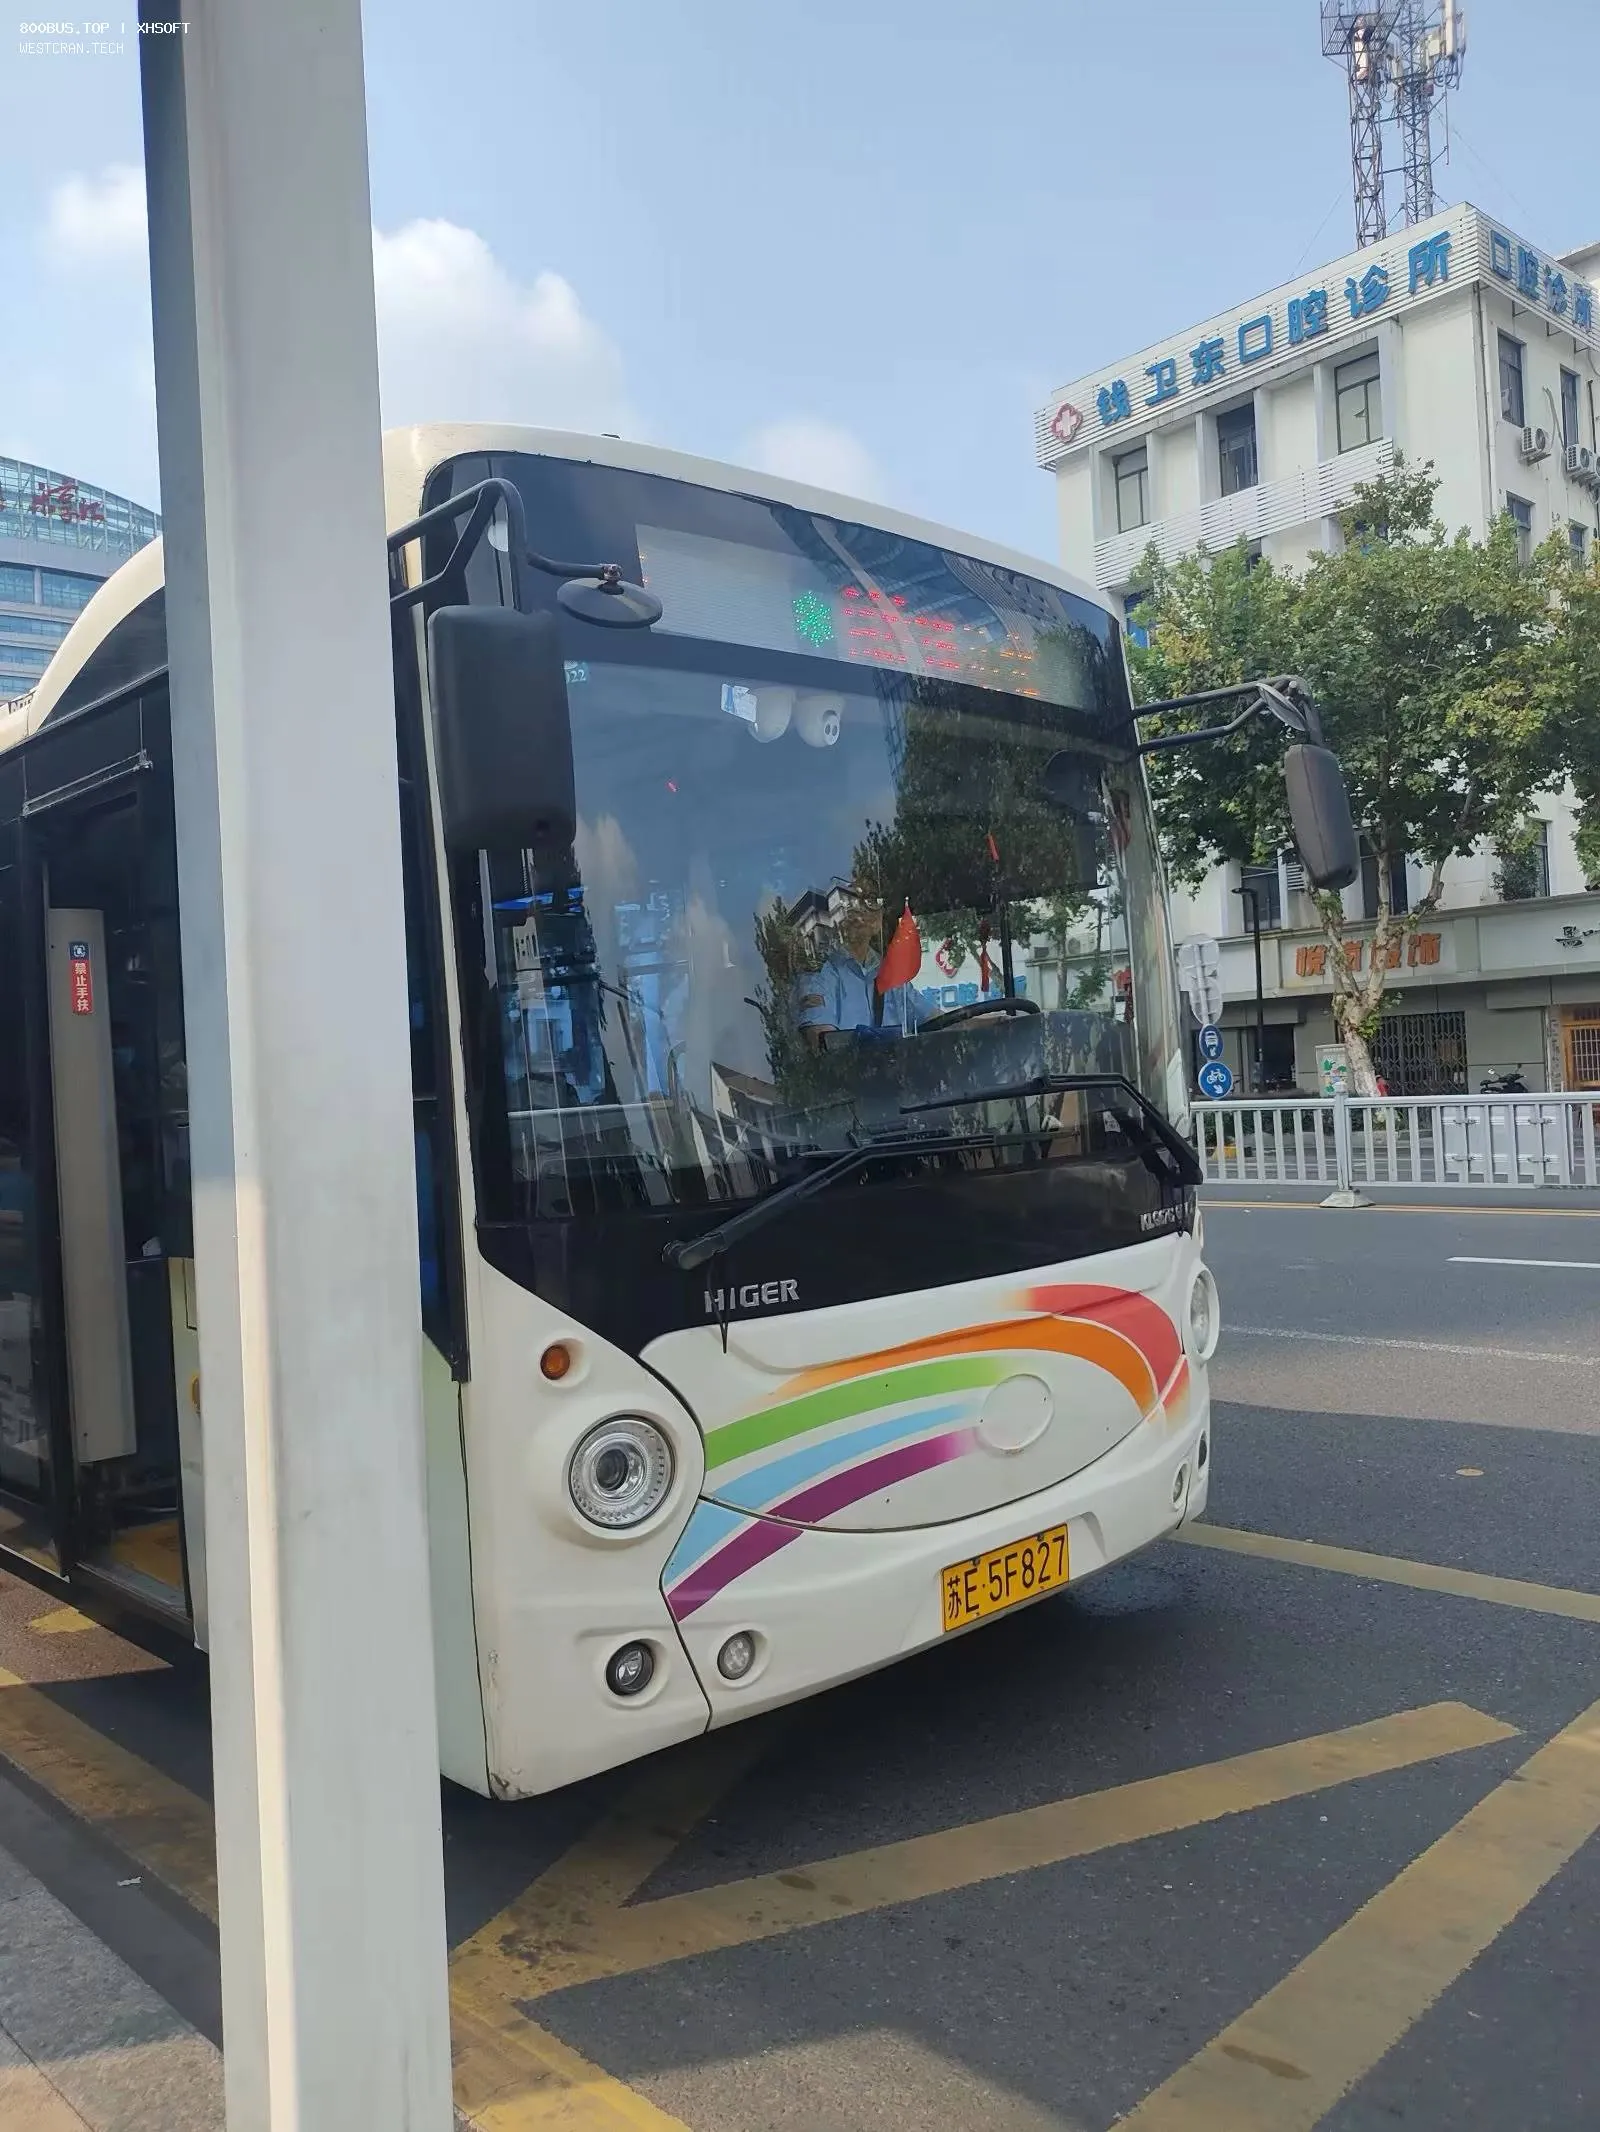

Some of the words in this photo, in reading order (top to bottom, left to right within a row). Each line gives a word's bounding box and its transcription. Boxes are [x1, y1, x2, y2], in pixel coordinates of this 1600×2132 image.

[1095, 230, 1452, 426] 钱卫东口腔诊所
[1489, 229, 1593, 334] 口腔诊所
[704, 1278, 800, 1313] HIGER
[946, 1534, 1066, 1620] 苏E·5F827
